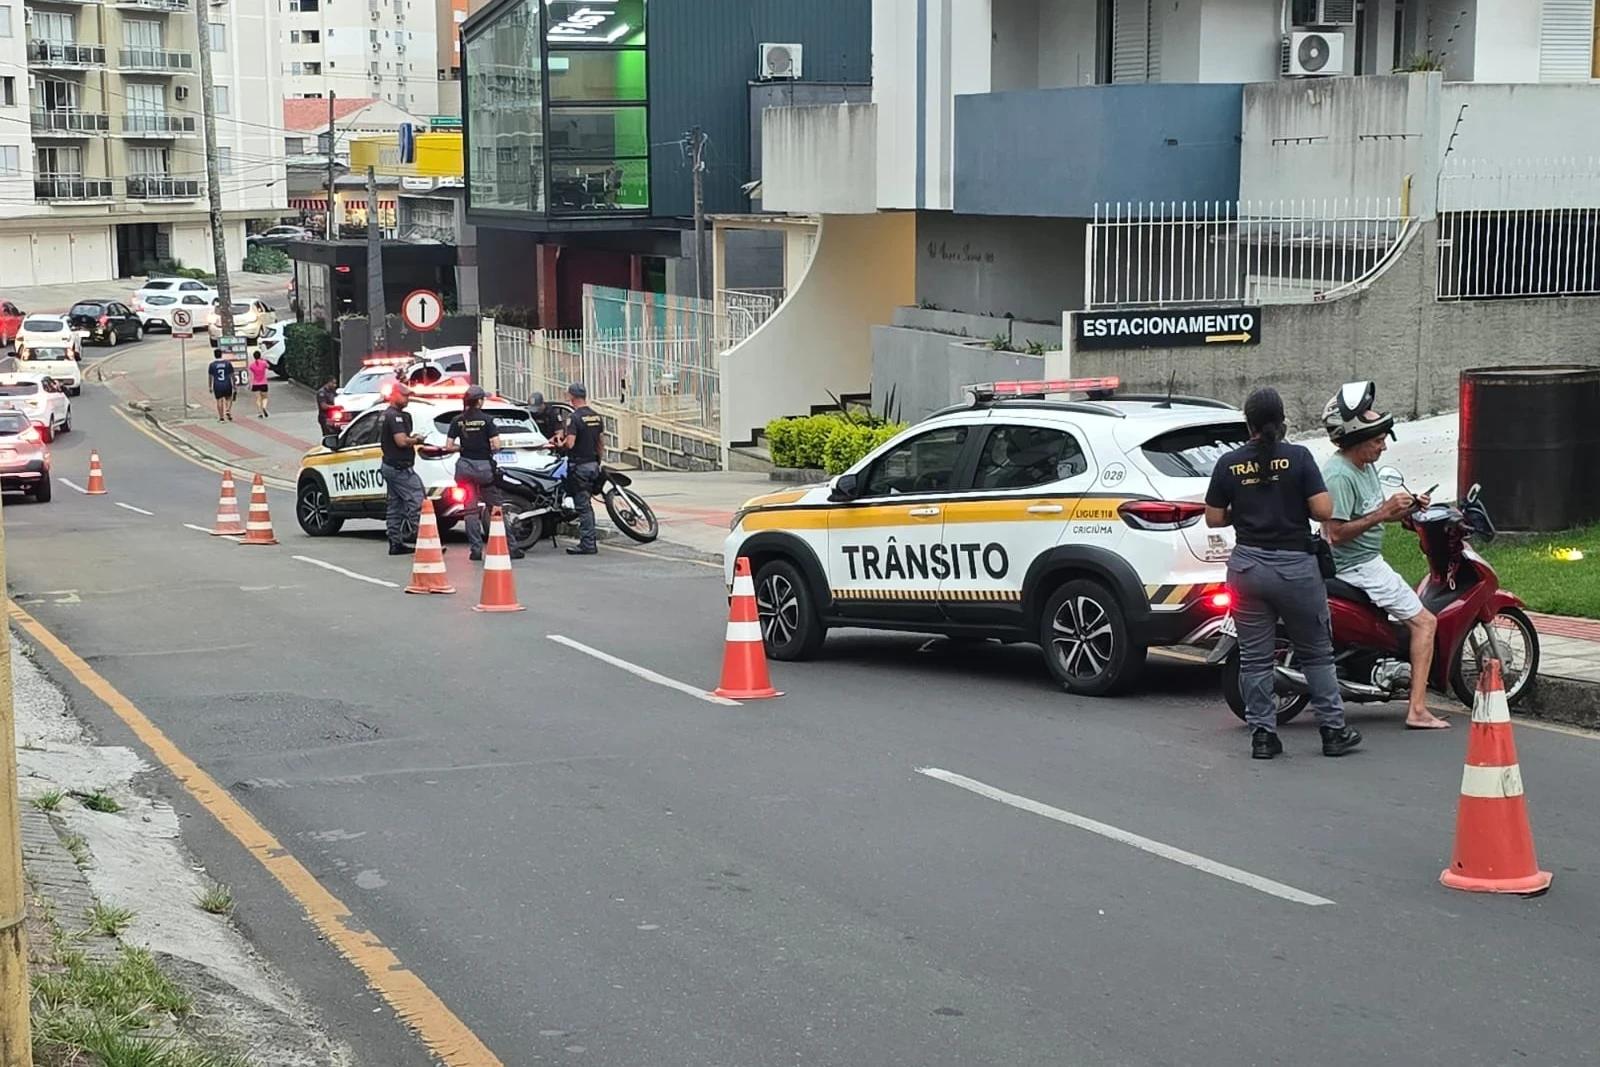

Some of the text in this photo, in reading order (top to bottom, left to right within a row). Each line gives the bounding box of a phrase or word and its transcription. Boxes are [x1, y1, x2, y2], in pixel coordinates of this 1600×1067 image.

[1083, 314, 1254, 337] ESTACIONAMENTO
[217, 369, 225, 381] 3
[333, 467, 384, 492] TRÂNSITO
[1103, 470, 1124, 481] 028
[1076, 509, 1100, 518] LIGUE
[1072, 523, 1113, 534] CRICIÚMA
[842, 536, 1009, 580] TRÂNSITO
